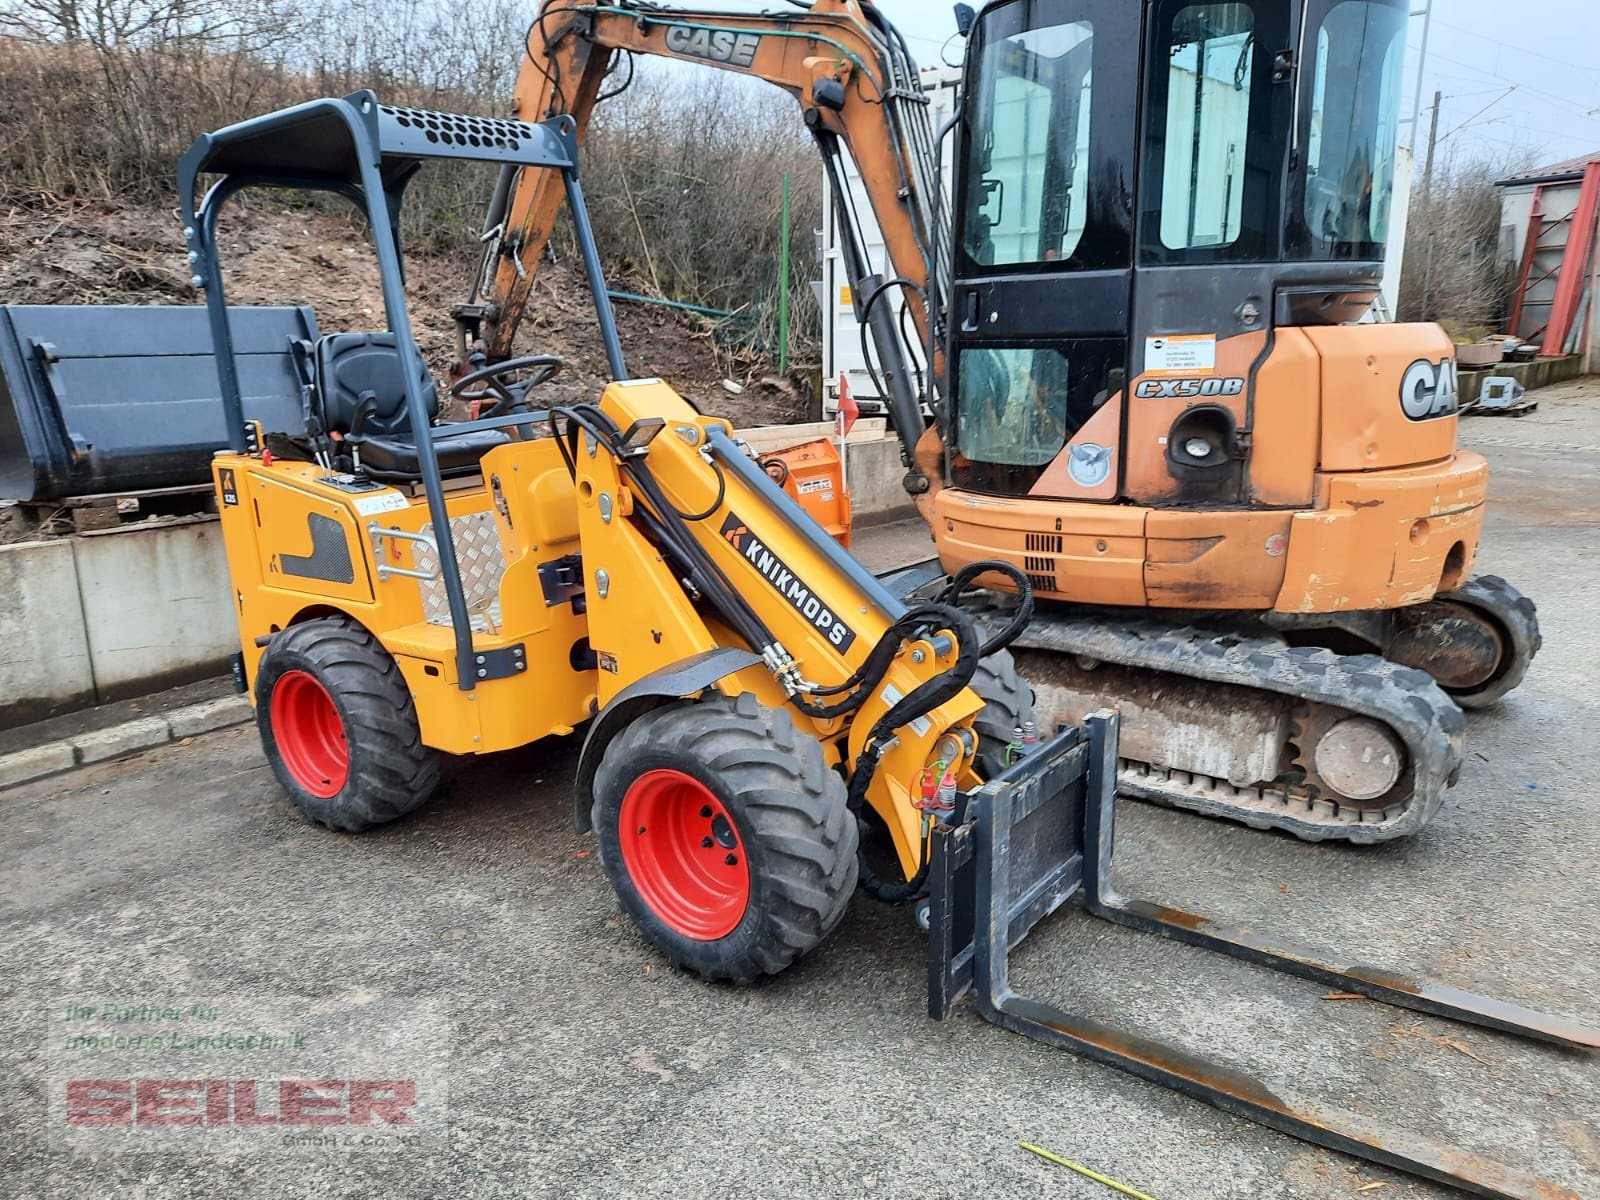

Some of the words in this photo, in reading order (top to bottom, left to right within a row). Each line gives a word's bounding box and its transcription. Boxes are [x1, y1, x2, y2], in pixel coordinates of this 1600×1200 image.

[665, 25, 761, 68] CASE
[1135, 377, 1245, 399] CX50B
[745, 539, 847, 645] KNIKMOPS
